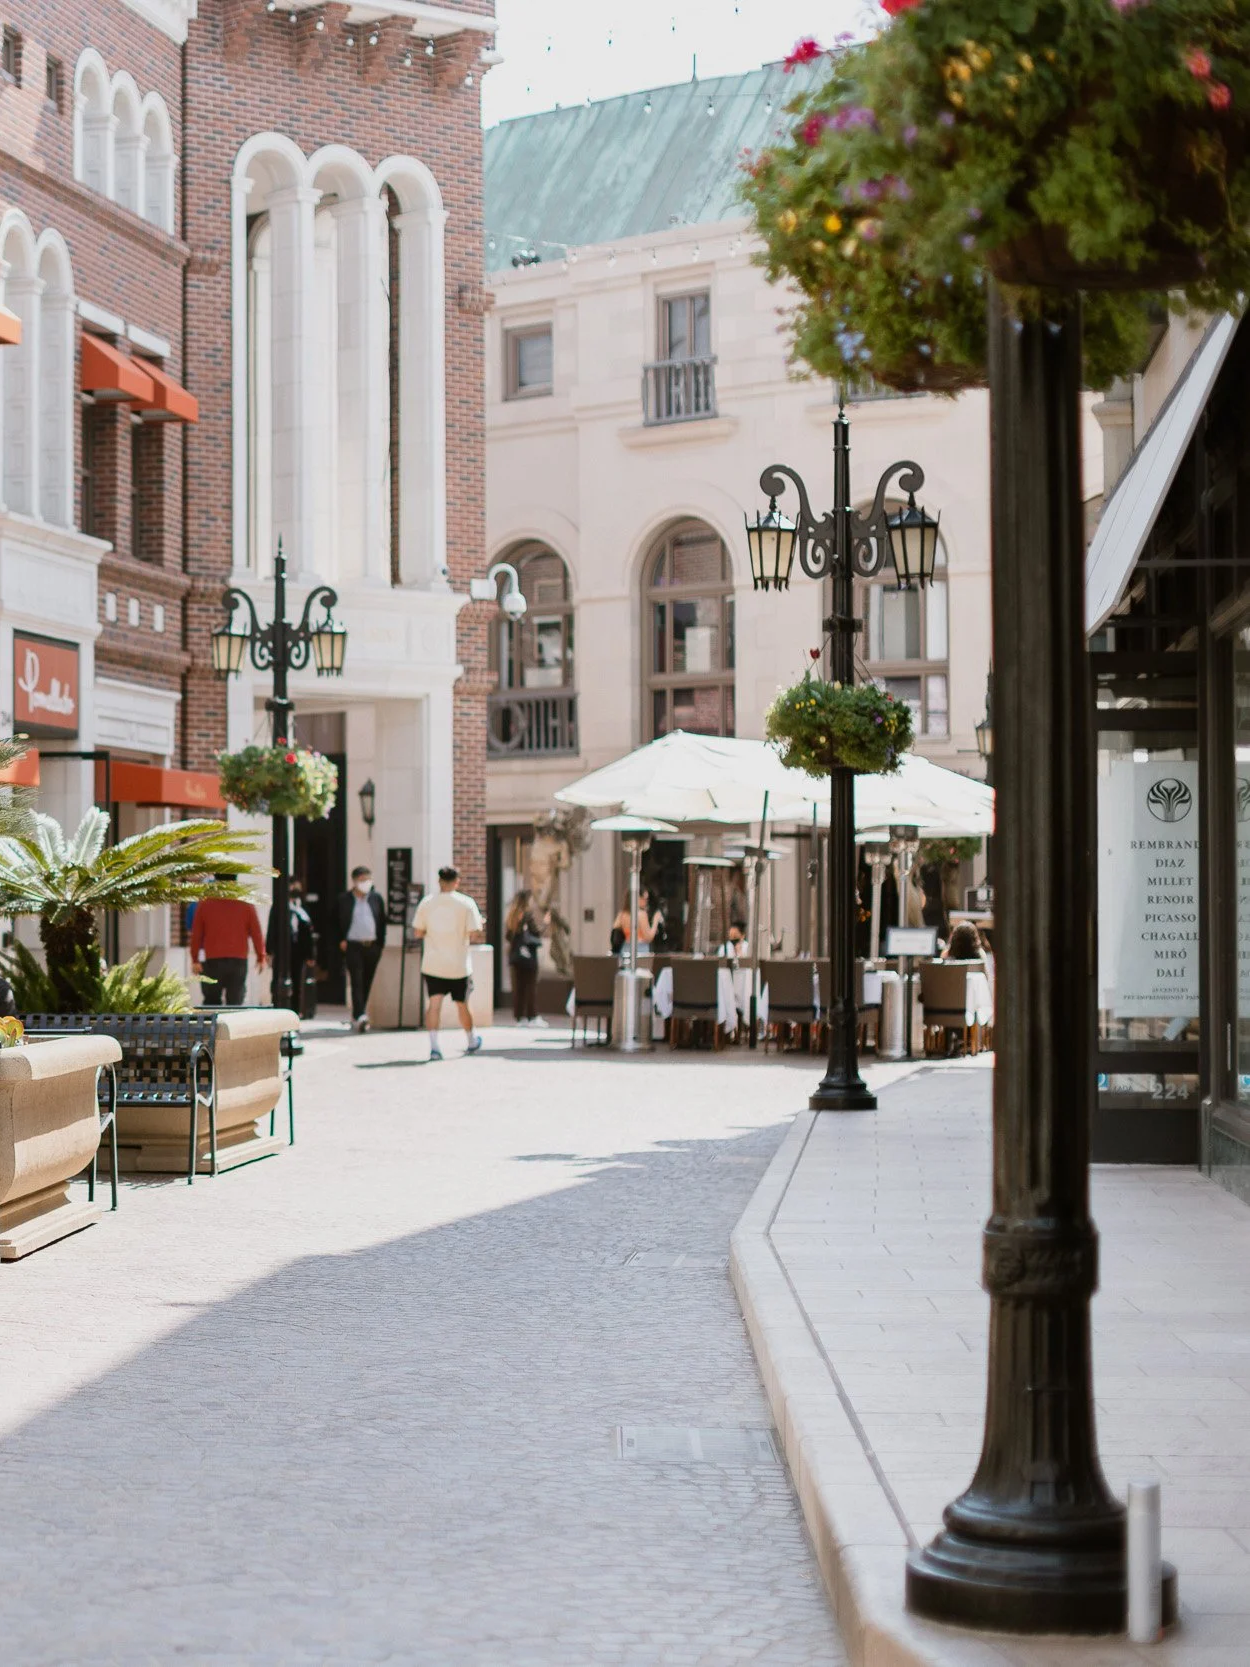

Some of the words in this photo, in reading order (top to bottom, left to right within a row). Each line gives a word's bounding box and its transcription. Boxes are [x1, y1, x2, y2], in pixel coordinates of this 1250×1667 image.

[1155, 859, 1185, 868] DIAZ
[1147, 877, 1193, 886] MILLET
[1147, 896, 1194, 904] RENOIR
[1144, 913, 1197, 922] PICASSO
[1154, 947, 1187, 959] MIRÓ
[1156, 966, 1186, 978] DALÍ
[1152, 1083, 1189, 1100] 224
